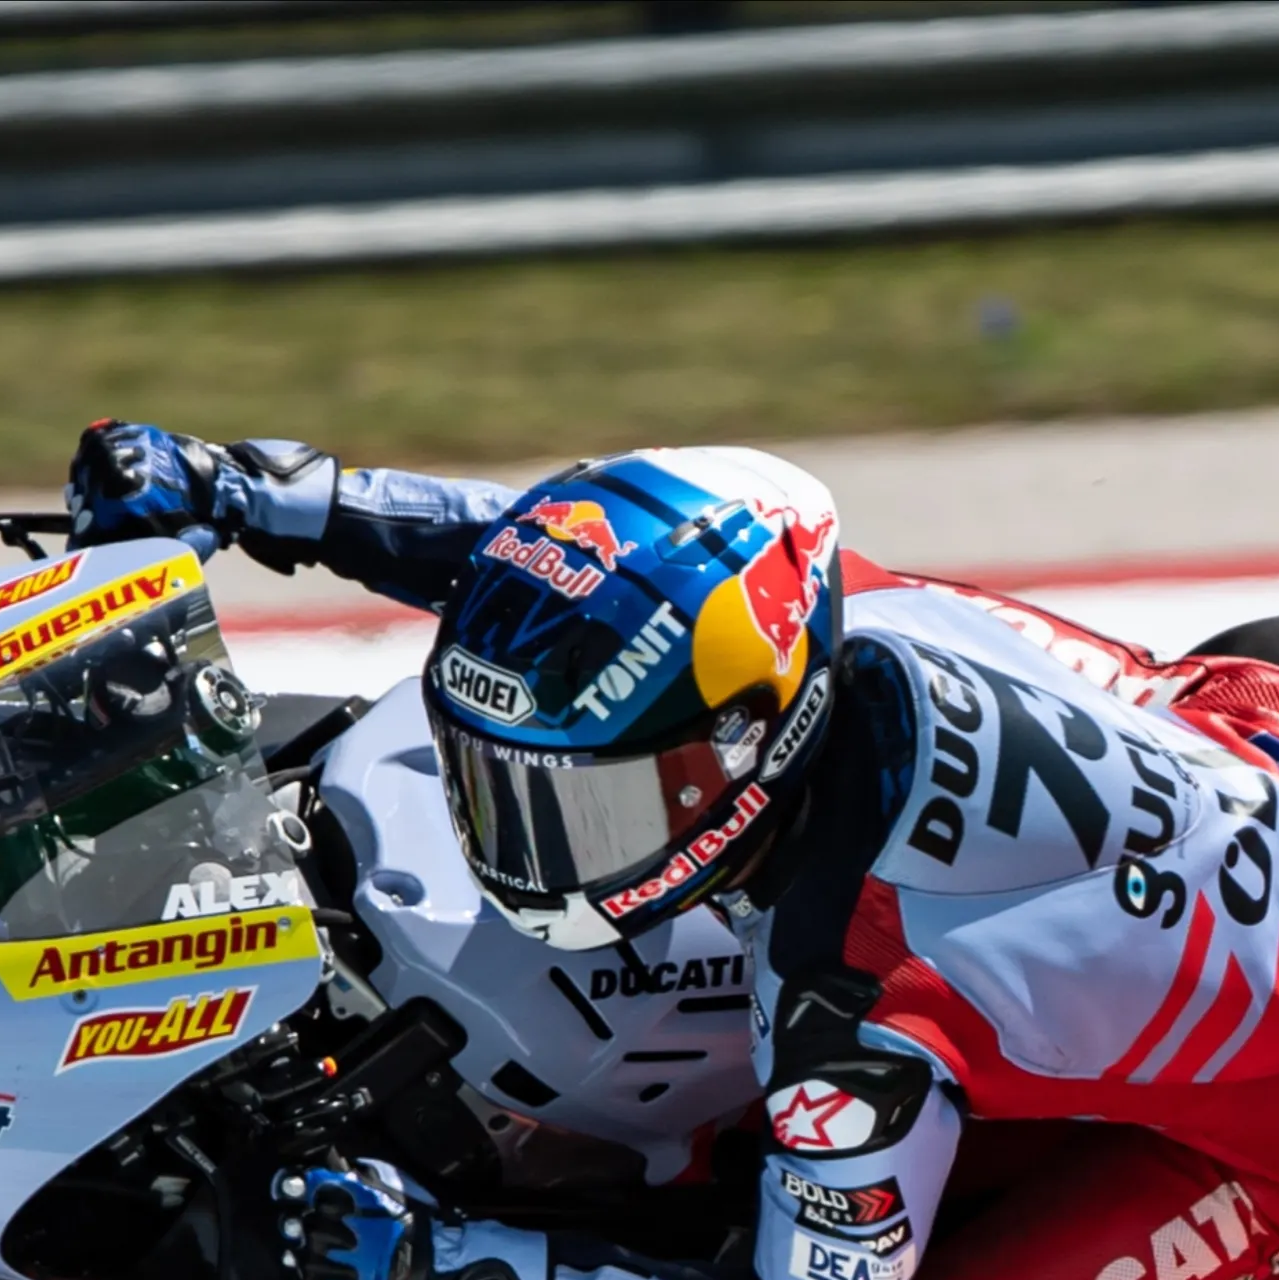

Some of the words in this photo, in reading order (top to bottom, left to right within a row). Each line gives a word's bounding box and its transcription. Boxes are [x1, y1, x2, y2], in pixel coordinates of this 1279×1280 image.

[483, 527, 537, 571] Red
[529, 546, 606, 598] Bull
[447, 656, 518, 715] SHOEI
[493, 744, 574, 770] WINGS
[771, 684, 825, 769] SHOEI
[602, 857, 697, 920] Red
[687, 782, 771, 866] Bull
[161, 871, 303, 921] ALEX
[29, 917, 277, 989] Antangin
[590, 954, 744, 1000] DUCATI
[73, 987, 238, 1058] YOU-ALL
[785, 1172, 849, 1211] BOLD
